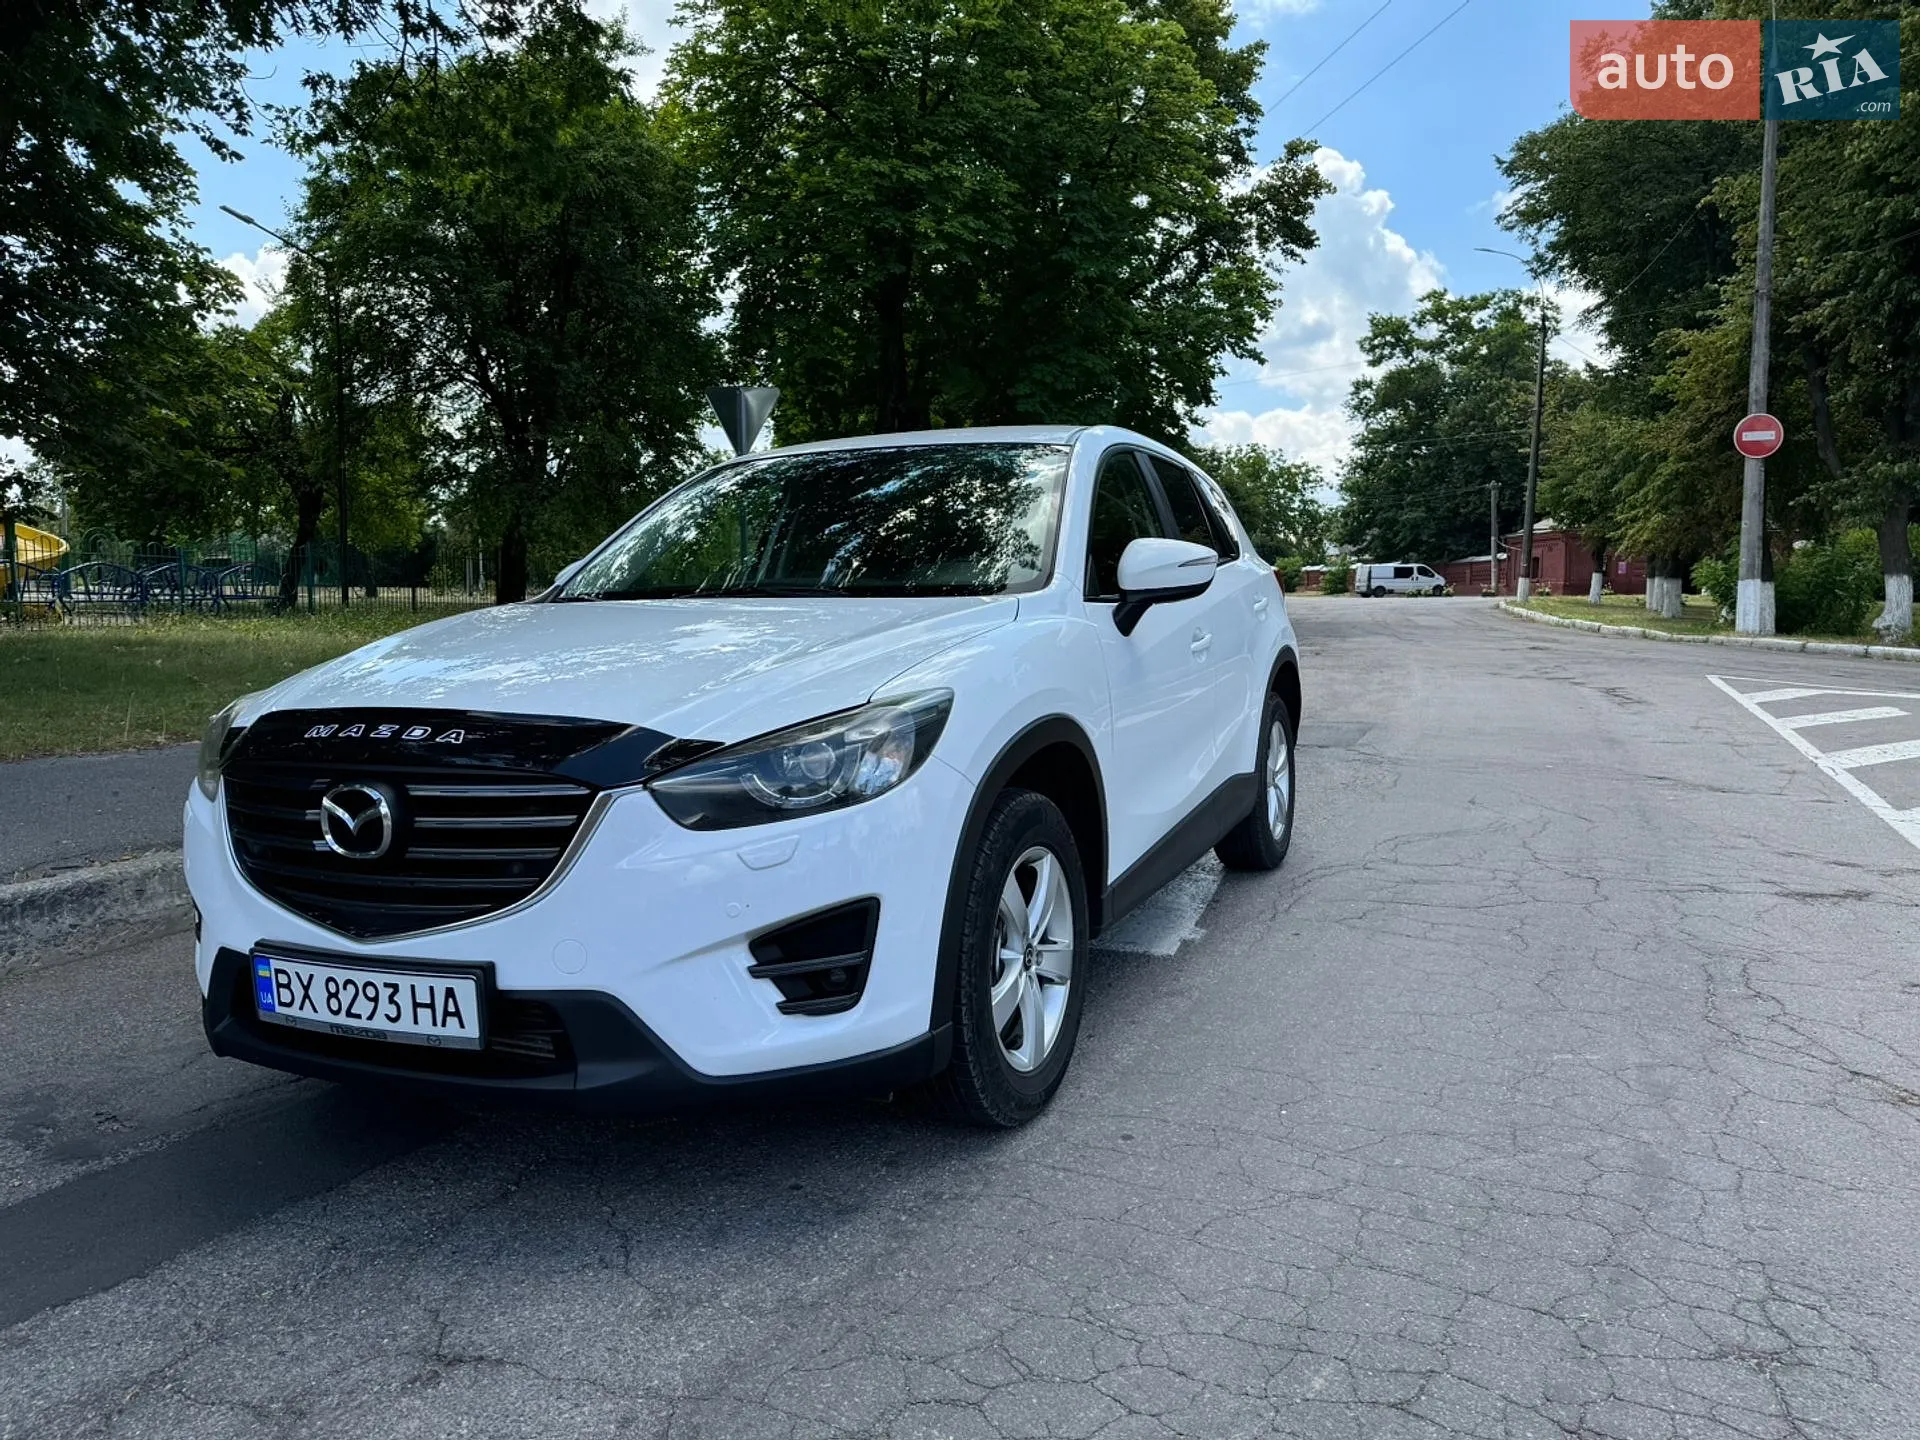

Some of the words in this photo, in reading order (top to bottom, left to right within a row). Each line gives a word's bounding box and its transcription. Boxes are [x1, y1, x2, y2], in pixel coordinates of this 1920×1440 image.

[304, 724, 465, 744] MAZDA
[260, 992, 273, 1006] UA
[274, 967, 318, 1014] BX
[325, 976, 401, 1024] 8293
[410, 984, 466, 1030] HA
